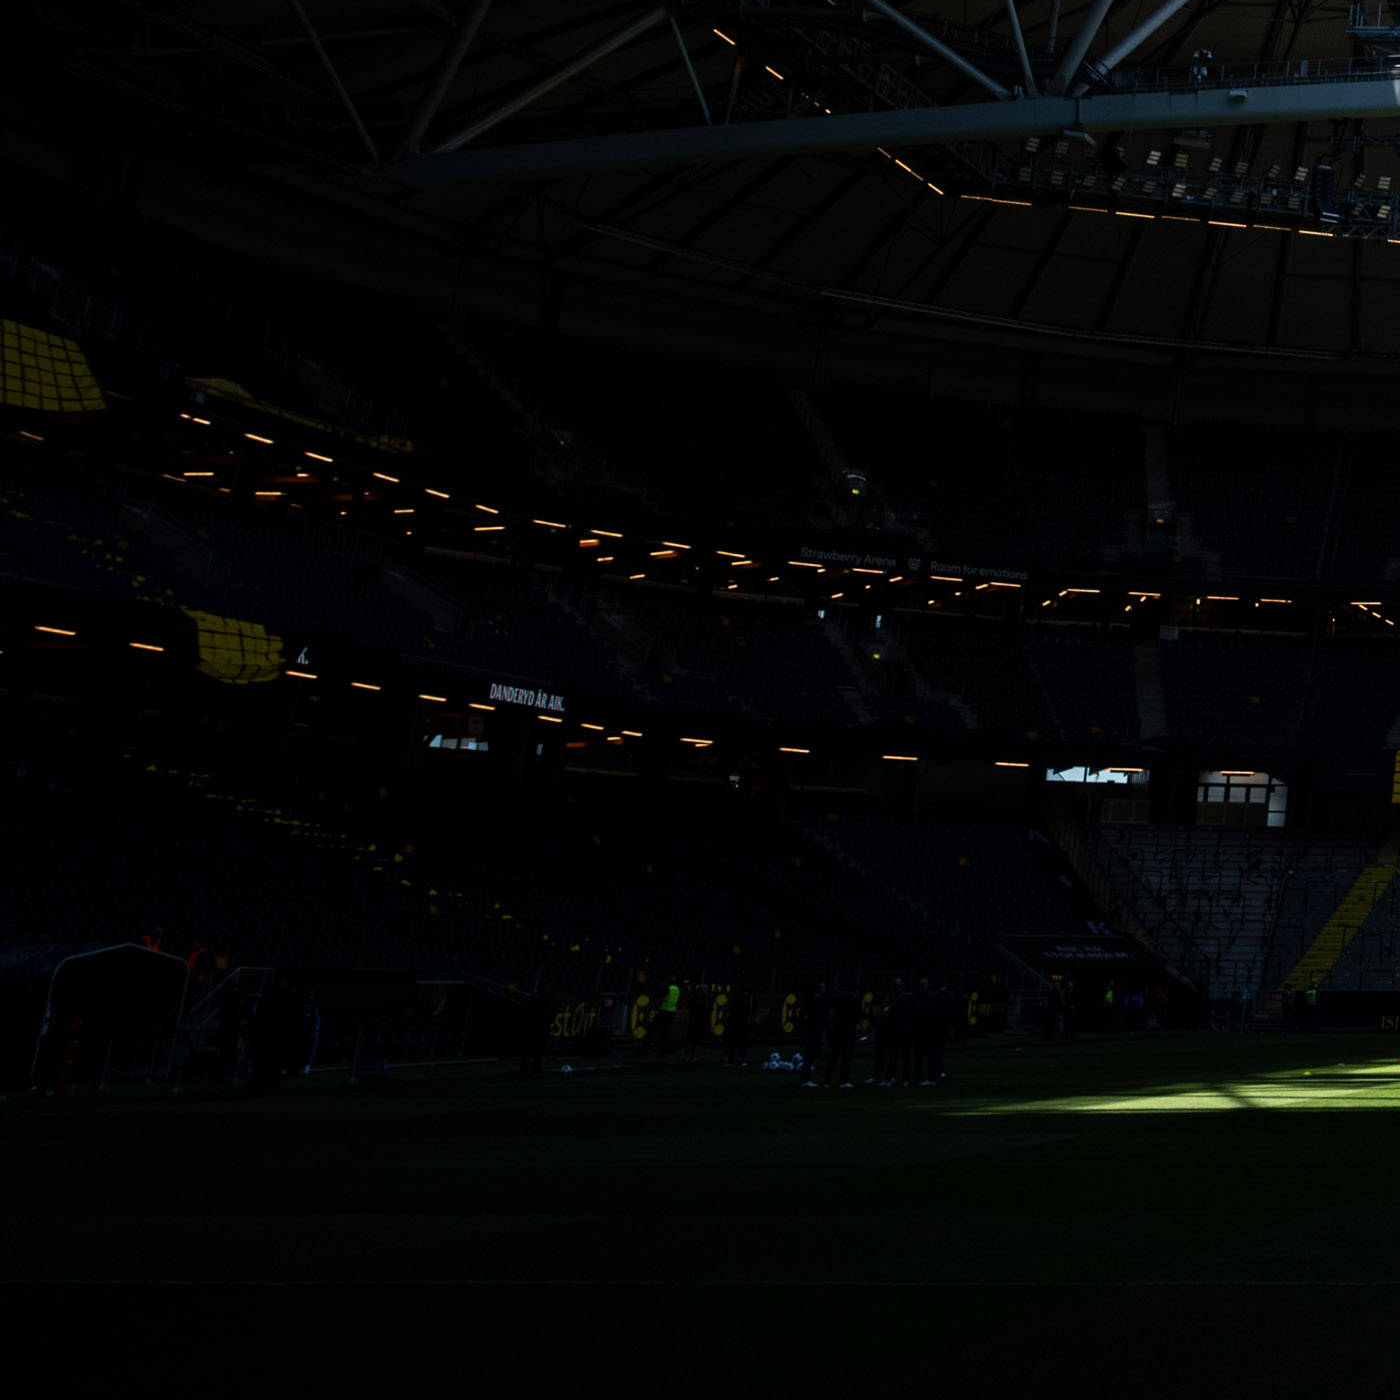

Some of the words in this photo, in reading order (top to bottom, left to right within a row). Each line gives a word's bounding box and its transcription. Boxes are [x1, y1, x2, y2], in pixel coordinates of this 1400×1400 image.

[800, 546, 863, 565] Strawberry
[864, 554, 897, 567] Arena
[930, 561, 962, 574] Room
[963, 565, 978, 575] for
[979, 568, 1028, 581] emotions
[489, 682, 535, 707] DANDERYD
